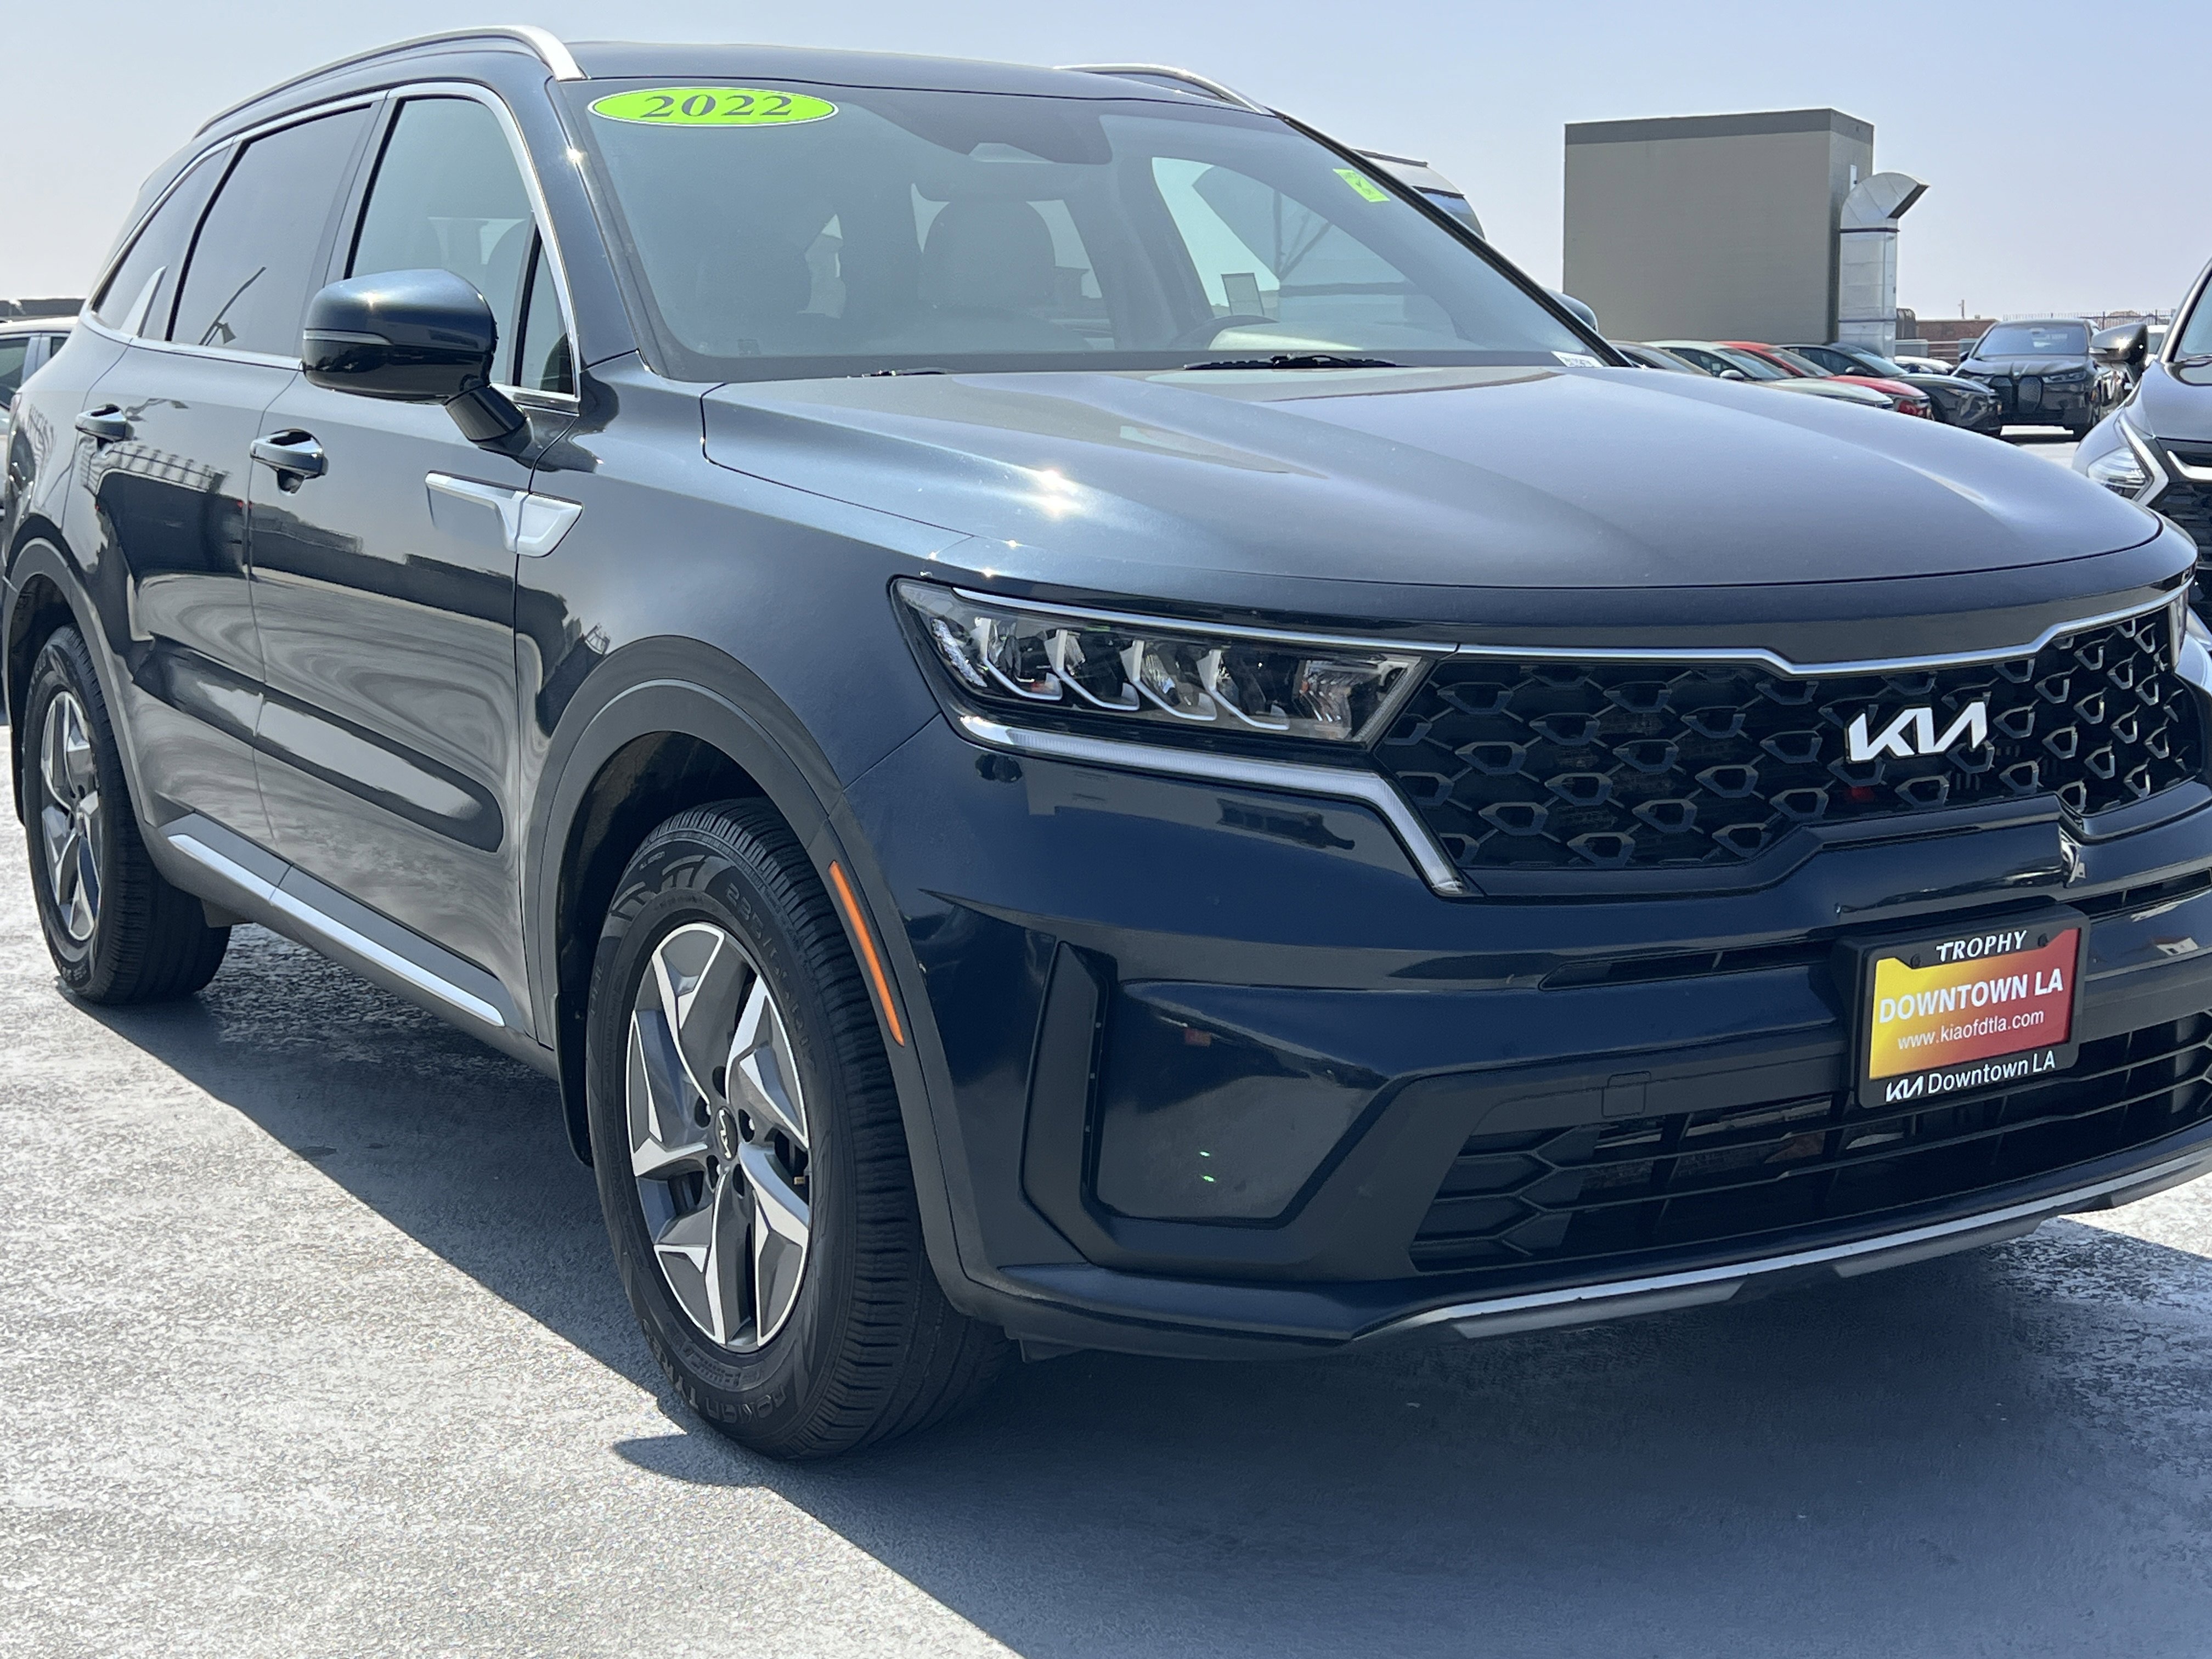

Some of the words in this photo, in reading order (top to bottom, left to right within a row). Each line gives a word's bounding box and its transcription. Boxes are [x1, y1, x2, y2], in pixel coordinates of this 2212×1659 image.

[640, 94, 792, 117] 2022
[1848, 701, 1988, 761] KIA
[1936, 930, 2028, 962] TROPHY
[1878, 973, 2029, 1024] DOWNTOWN
[2034, 968, 2063, 996] LA
[1898, 1009, 2045, 1050] www.kiaofdtla.com
[1886, 1075, 1924, 1102] KIA
[1928, 1059, 2029, 1094] Downtown
[2032, 1050, 2056, 1073] LA
